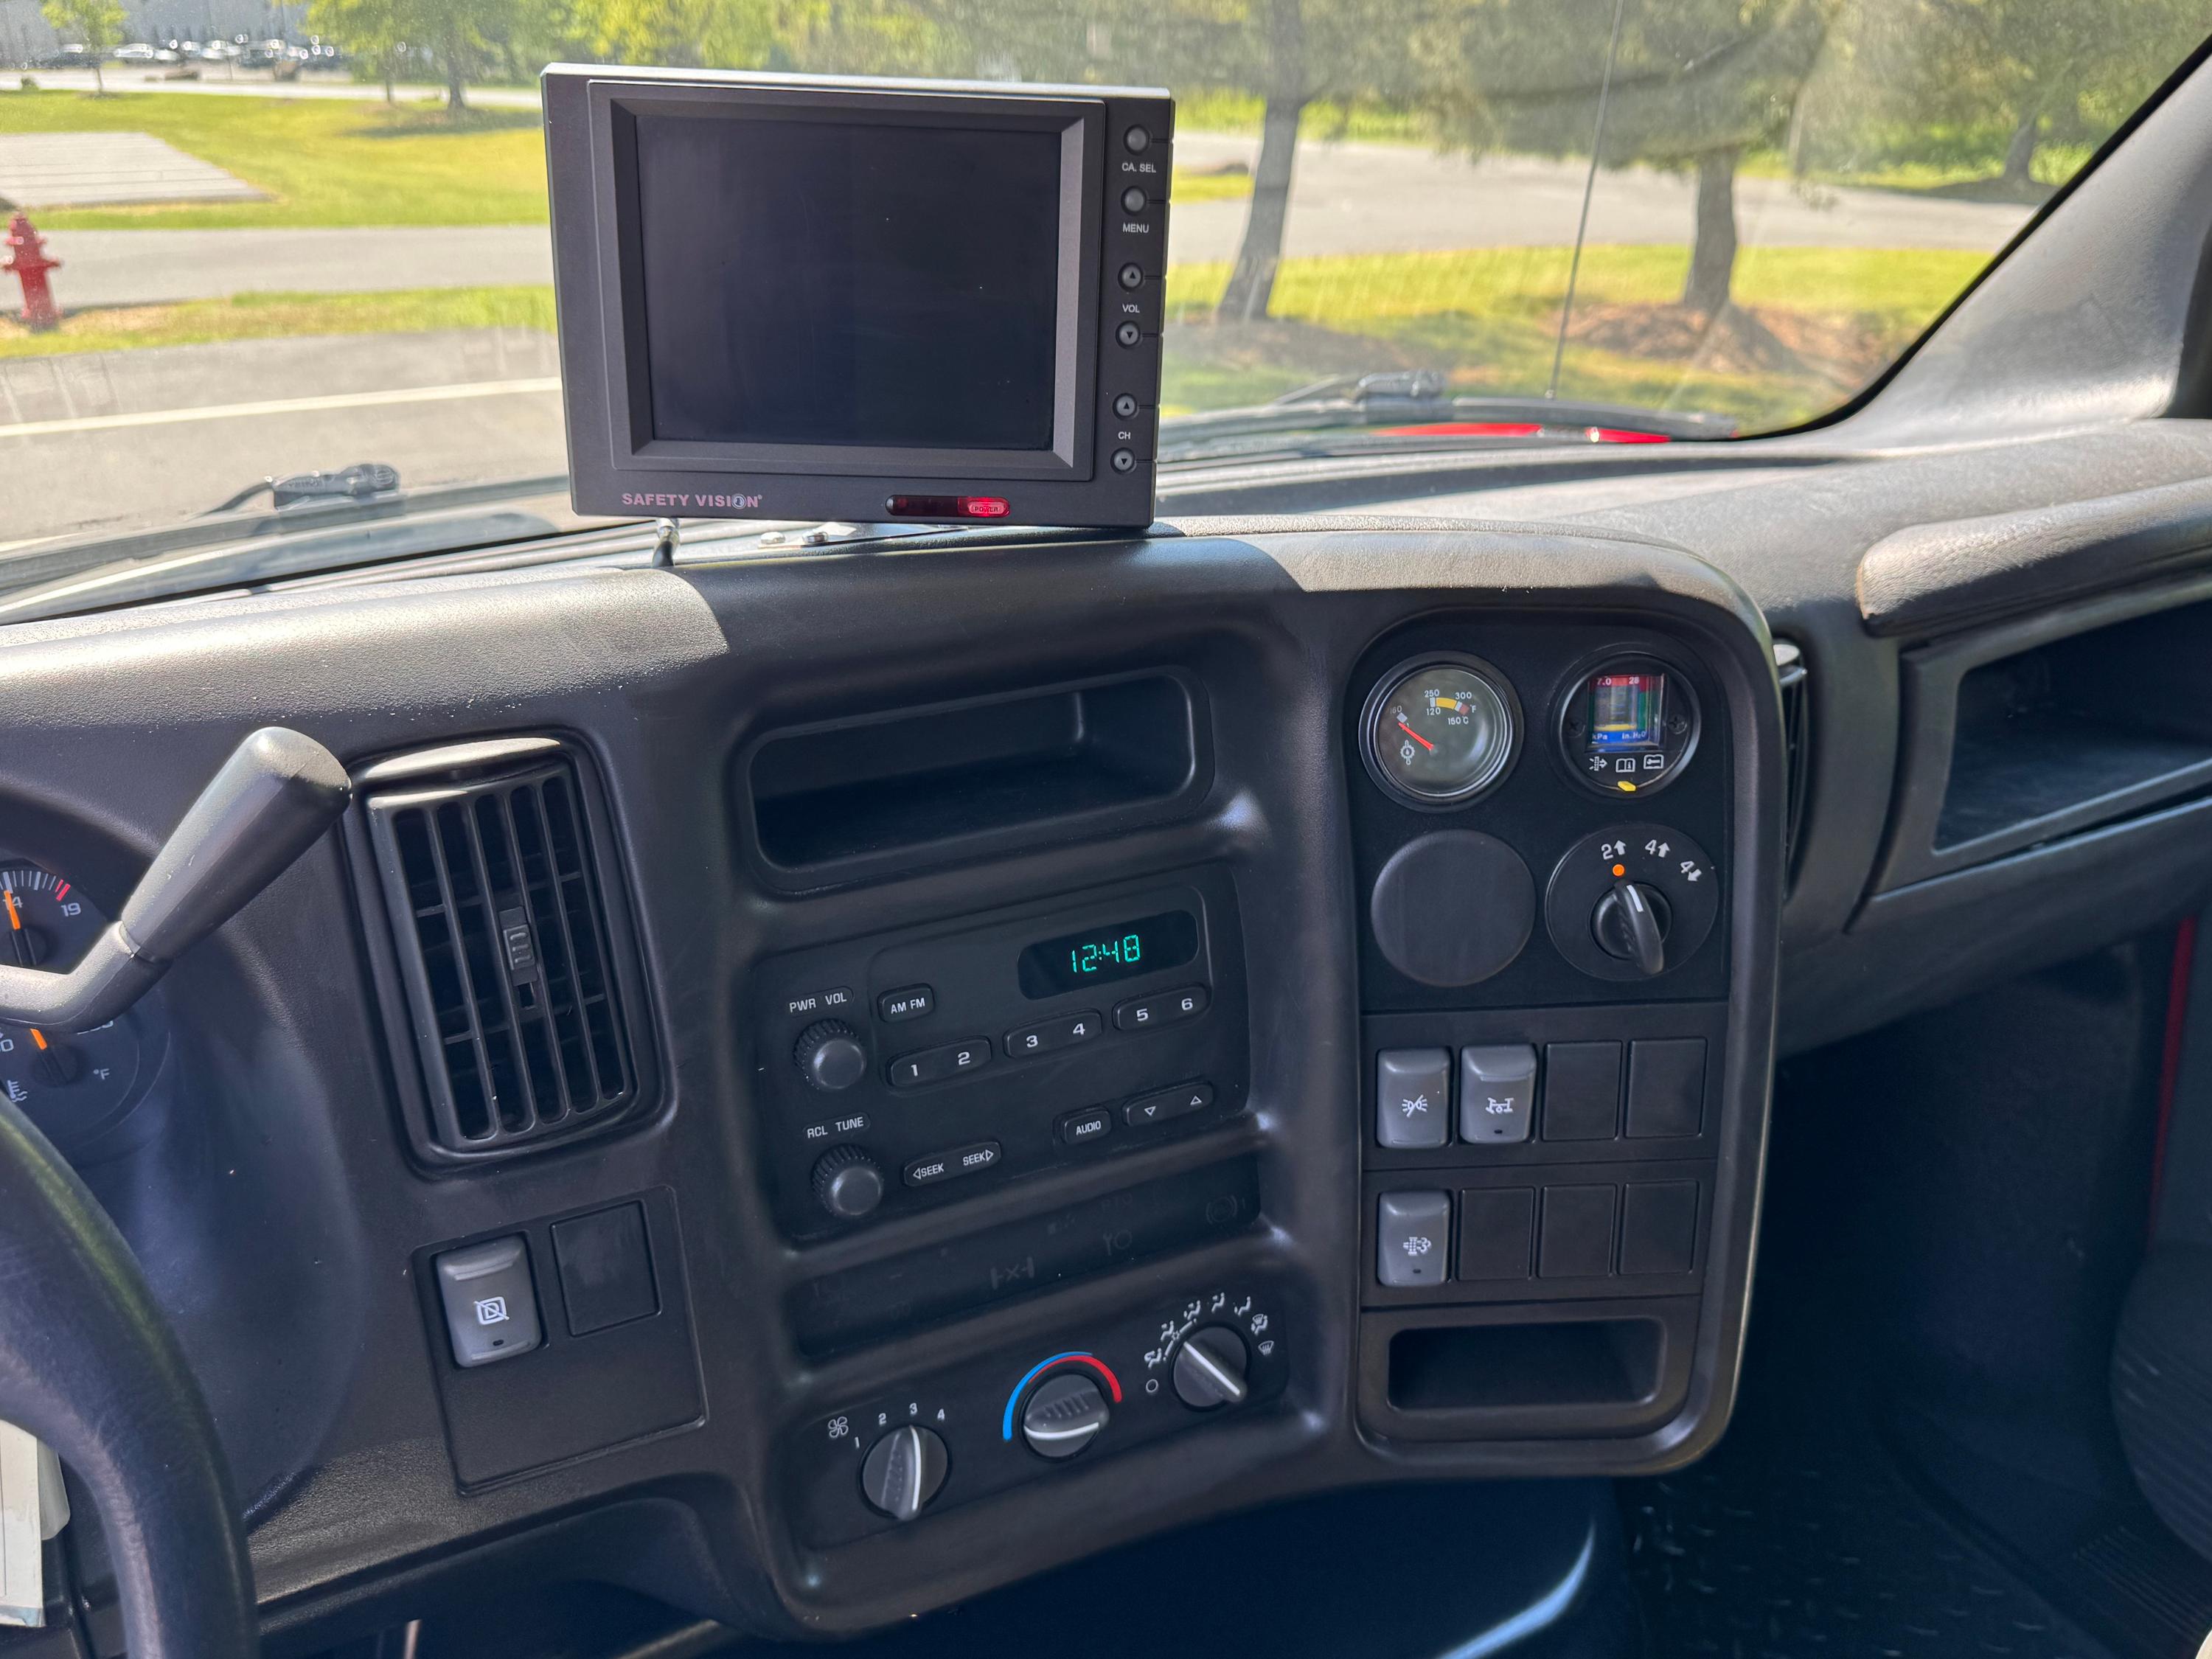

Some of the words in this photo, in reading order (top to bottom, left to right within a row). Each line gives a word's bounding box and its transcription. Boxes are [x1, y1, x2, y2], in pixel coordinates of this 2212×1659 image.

[1139, 163, 1156, 173] SEL
[1122, 222, 1150, 234] MENU
[1122, 304, 1140, 313] VOL
[1118, 431, 1131, 440] CH
[622, 493, 689, 507] SAFETY
[1597, 677, 1612, 686] 7.0
[1628, 676, 1640, 685] 28
[1424, 689, 1440, 698] 250
[1455, 691, 1472, 700] 300
[1426, 707, 1441, 716] 120
[1592, 732, 1608, 740] kPa
[1601, 844, 1614, 860] 2
[1644, 839, 1658, 855] 4
[1680, 860, 1694, 874] 4
[60, 902, 81, 917] 19
[1071, 934, 1141, 973] 12:48
[789, 998, 816, 1013] PWR
[825, 992, 847, 1006] VOL
[890, 1001, 907, 1015] AM
[910, 997, 925, 1010] FM
[1181, 998, 1194, 1011] 6
[1136, 1008, 1149, 1021] 5
[1072, 1023, 1085, 1036] 4
[1026, 1034, 1038, 1048] 3
[957, 1051, 970, 1065] 2
[911, 1064, 919, 1077] 1
[807, 1125, 828, 1138] RCL
[835, 1116, 864, 1133] TUNE
[1075, 1120, 1102, 1136] AUDIO
[962, 1152, 985, 1166] SEEK
[921, 1163, 945, 1178] SEEK
[909, 1402, 918, 1415] 3
[937, 1408, 945, 1421] 4
[878, 1413, 887, 1425] 2
